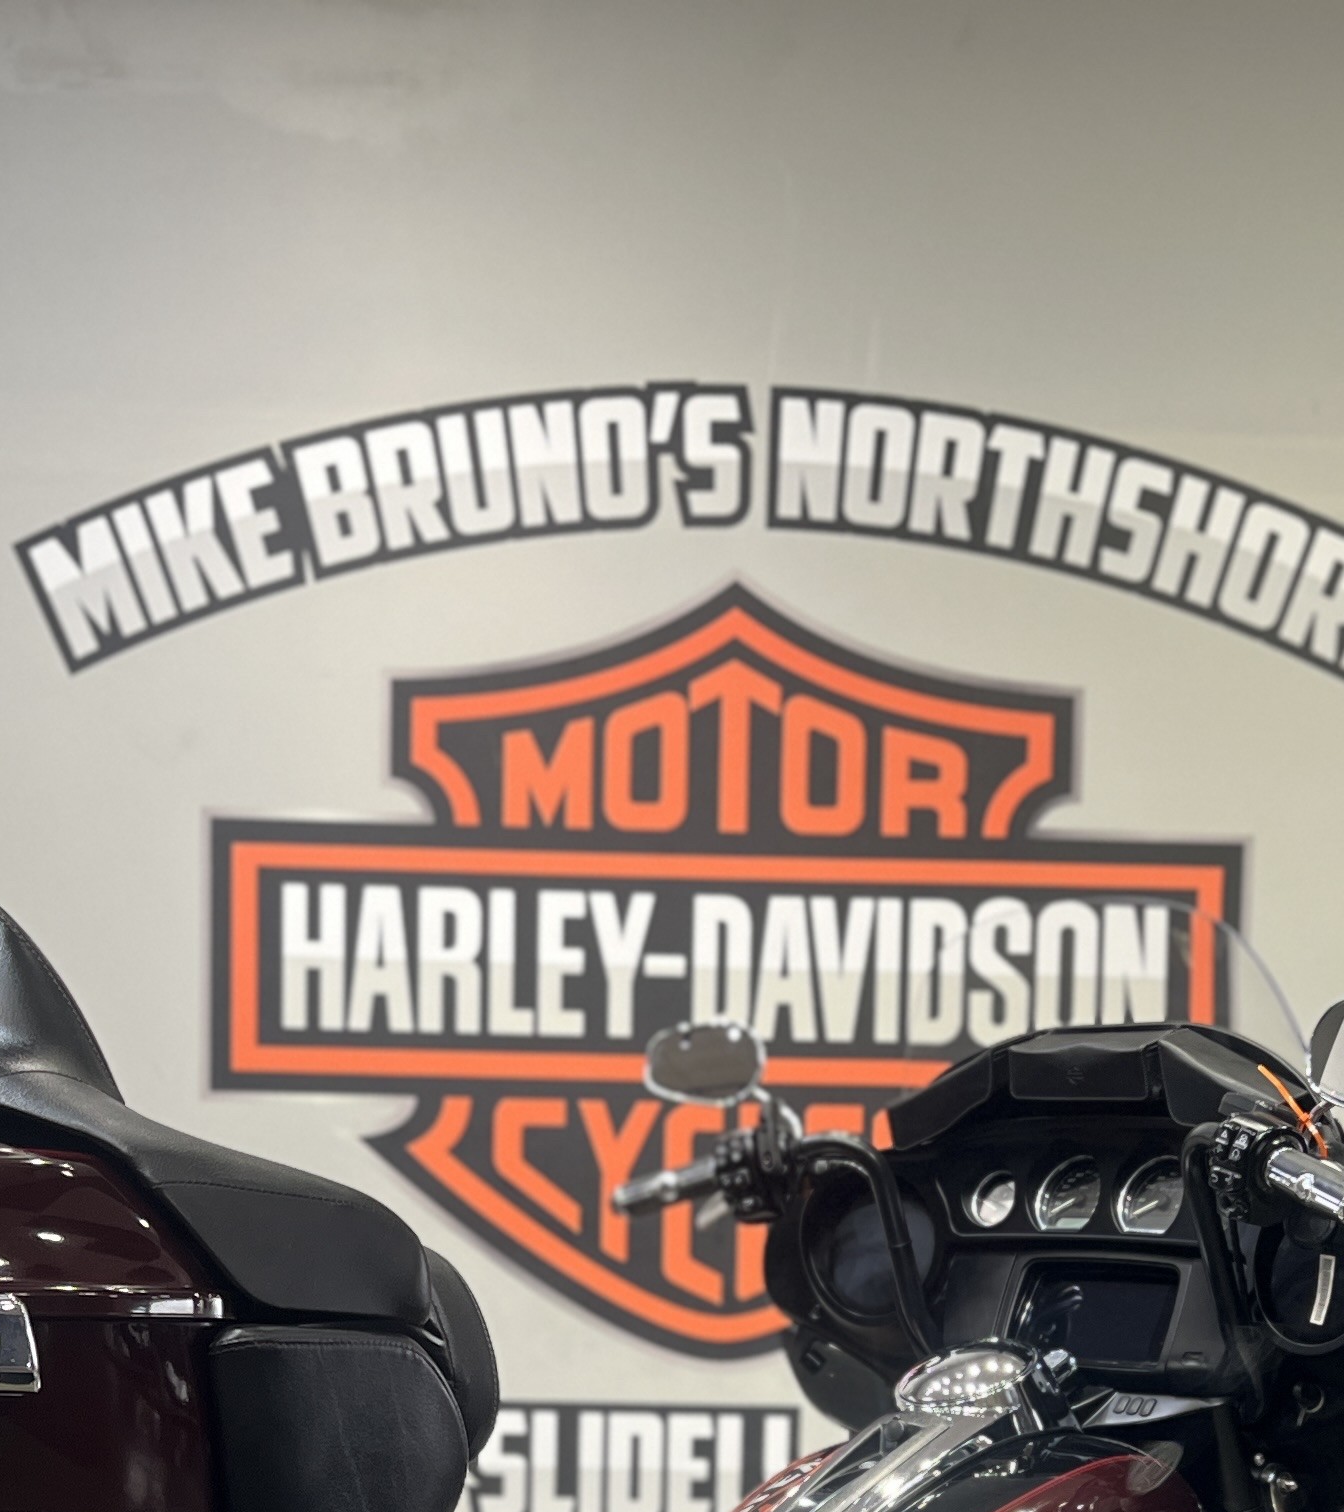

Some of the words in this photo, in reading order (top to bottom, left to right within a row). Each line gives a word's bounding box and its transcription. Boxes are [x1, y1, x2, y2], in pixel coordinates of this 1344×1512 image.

[29, 457, 294, 658] MIKE
[295, 391, 750, 567] BRUNO'S
[500, 657, 968, 838] MOTOR
[279, 881, 1171, 1050] HARLEY-DAVIDSON
